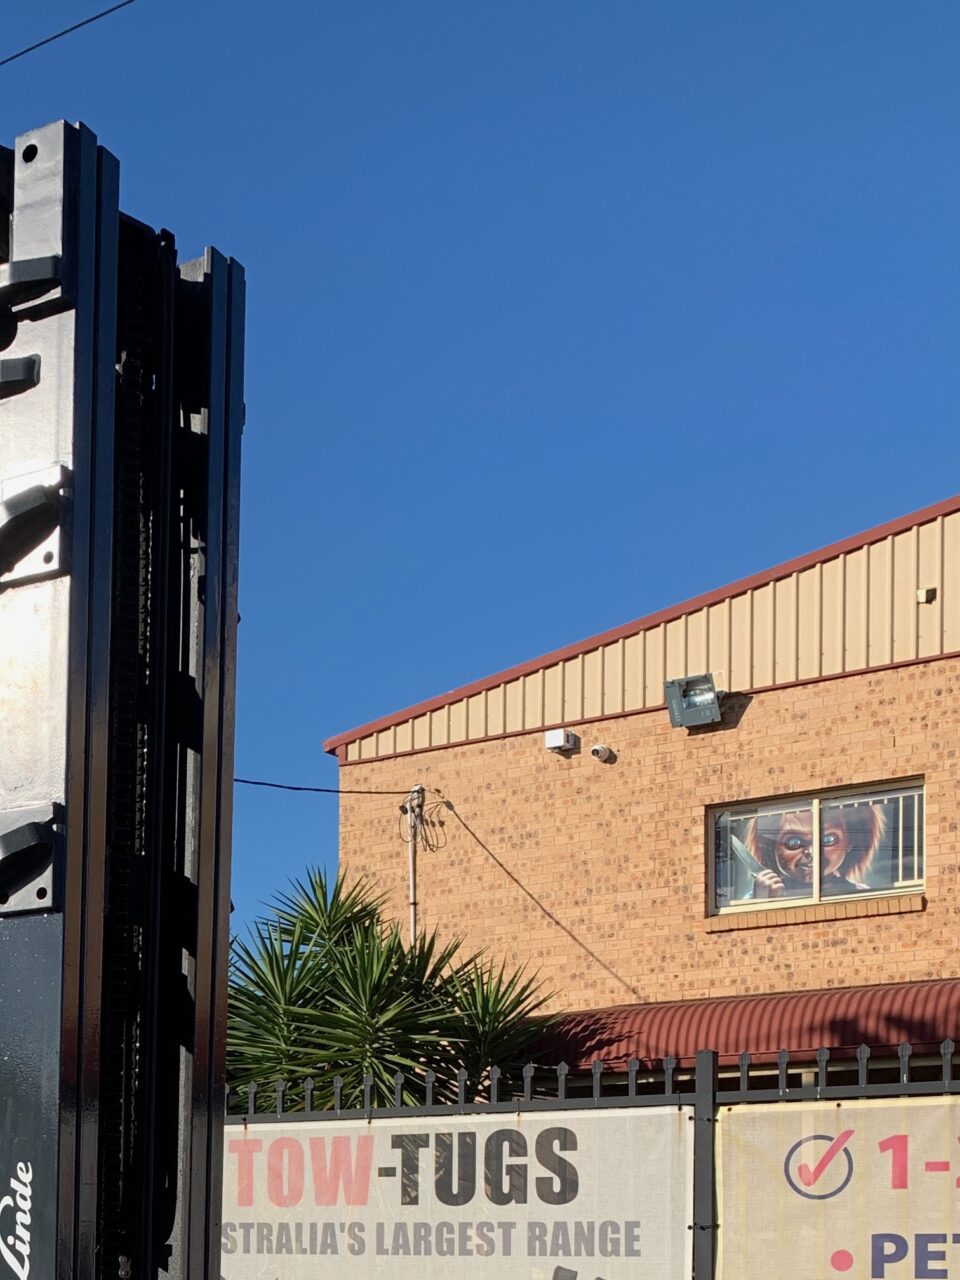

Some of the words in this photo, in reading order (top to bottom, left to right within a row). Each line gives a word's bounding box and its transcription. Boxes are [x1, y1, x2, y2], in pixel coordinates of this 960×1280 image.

[228, 1126, 580, 1208] TOW-TUGS
[376, 1220, 517, 1259] LARGEST
[527, 1221, 642, 1259] RANGE
